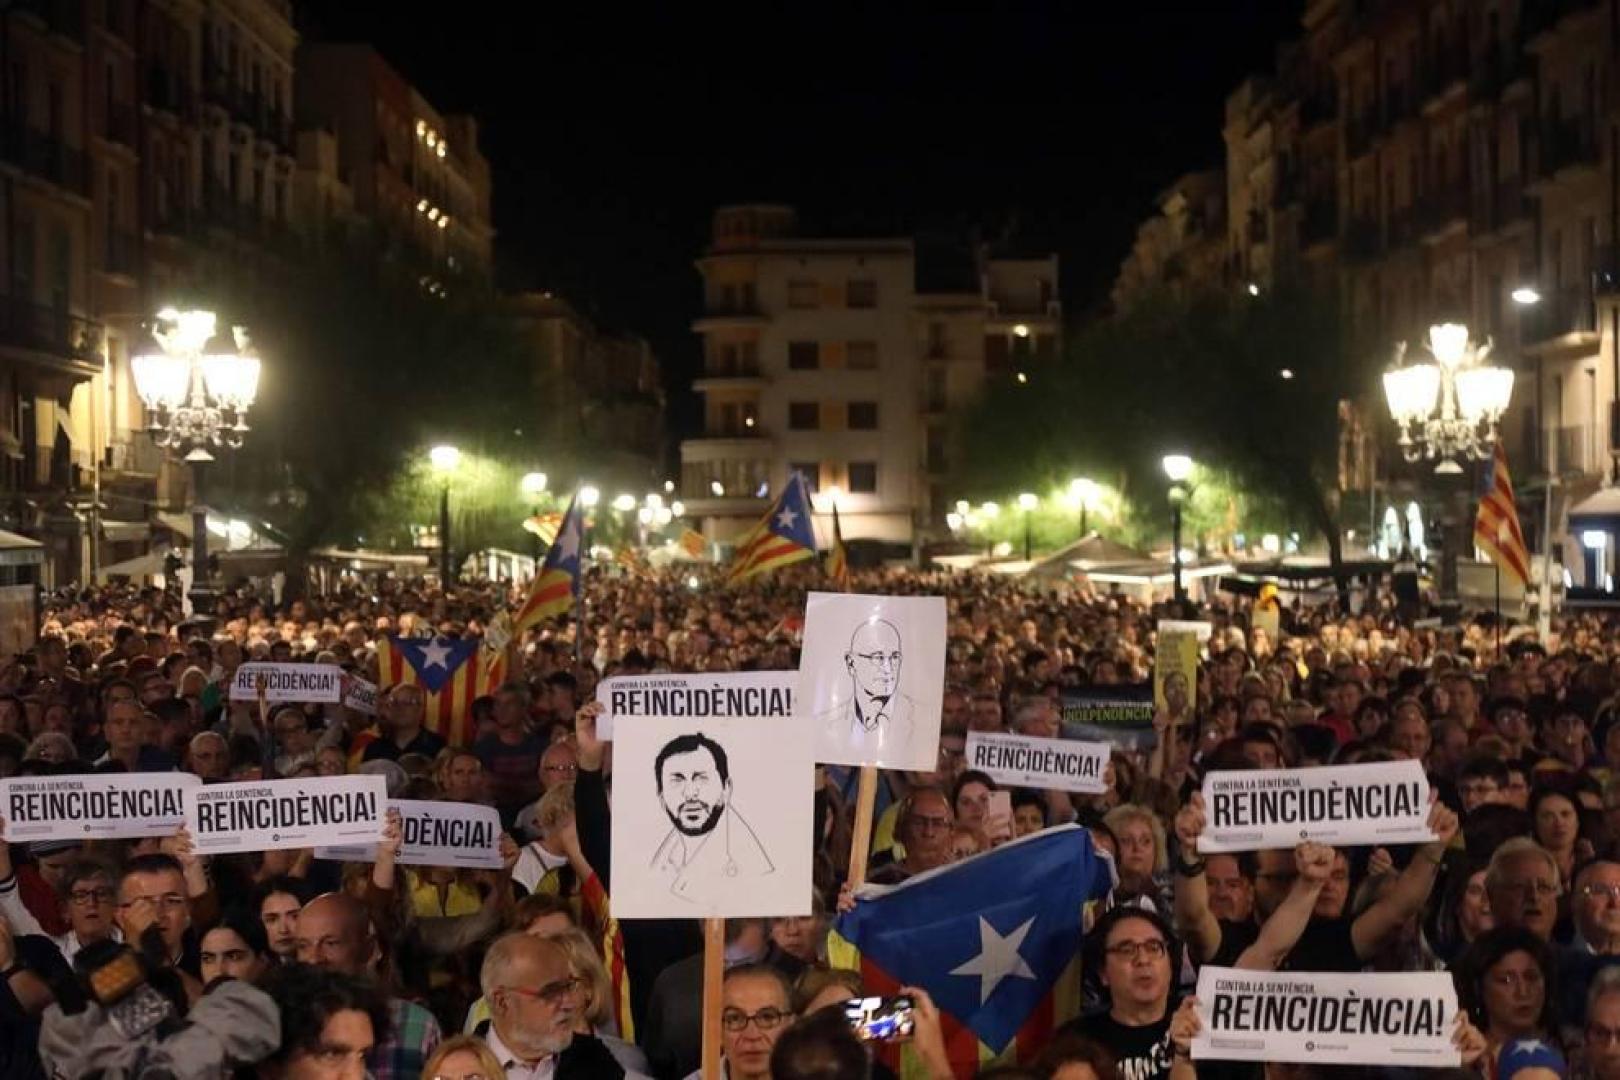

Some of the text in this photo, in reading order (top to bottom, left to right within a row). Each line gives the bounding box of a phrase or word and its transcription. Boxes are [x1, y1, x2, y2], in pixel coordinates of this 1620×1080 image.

[239, 670, 334, 690] RECIDÈNCIA!
[612, 683, 791, 717] REINCIDÈNCIA!
[975, 745, 1100, 778] REINCIDÈNCIA!
[1213, 780, 1244, 791] CONTRA
[1246, 779, 1256, 789] LA
[10, 785, 183, 821] REINCIDÈNCIA!
[197, 790, 377, 833] REINCIDÈNCIA!
[1213, 780, 1420, 827] REINCIDÈNCIA!
[1216, 980, 1250, 992] CONTRA
[1253, 981, 1264, 992] LA
[1212, 990, 1444, 1036] REINCIDÈNCIA!
